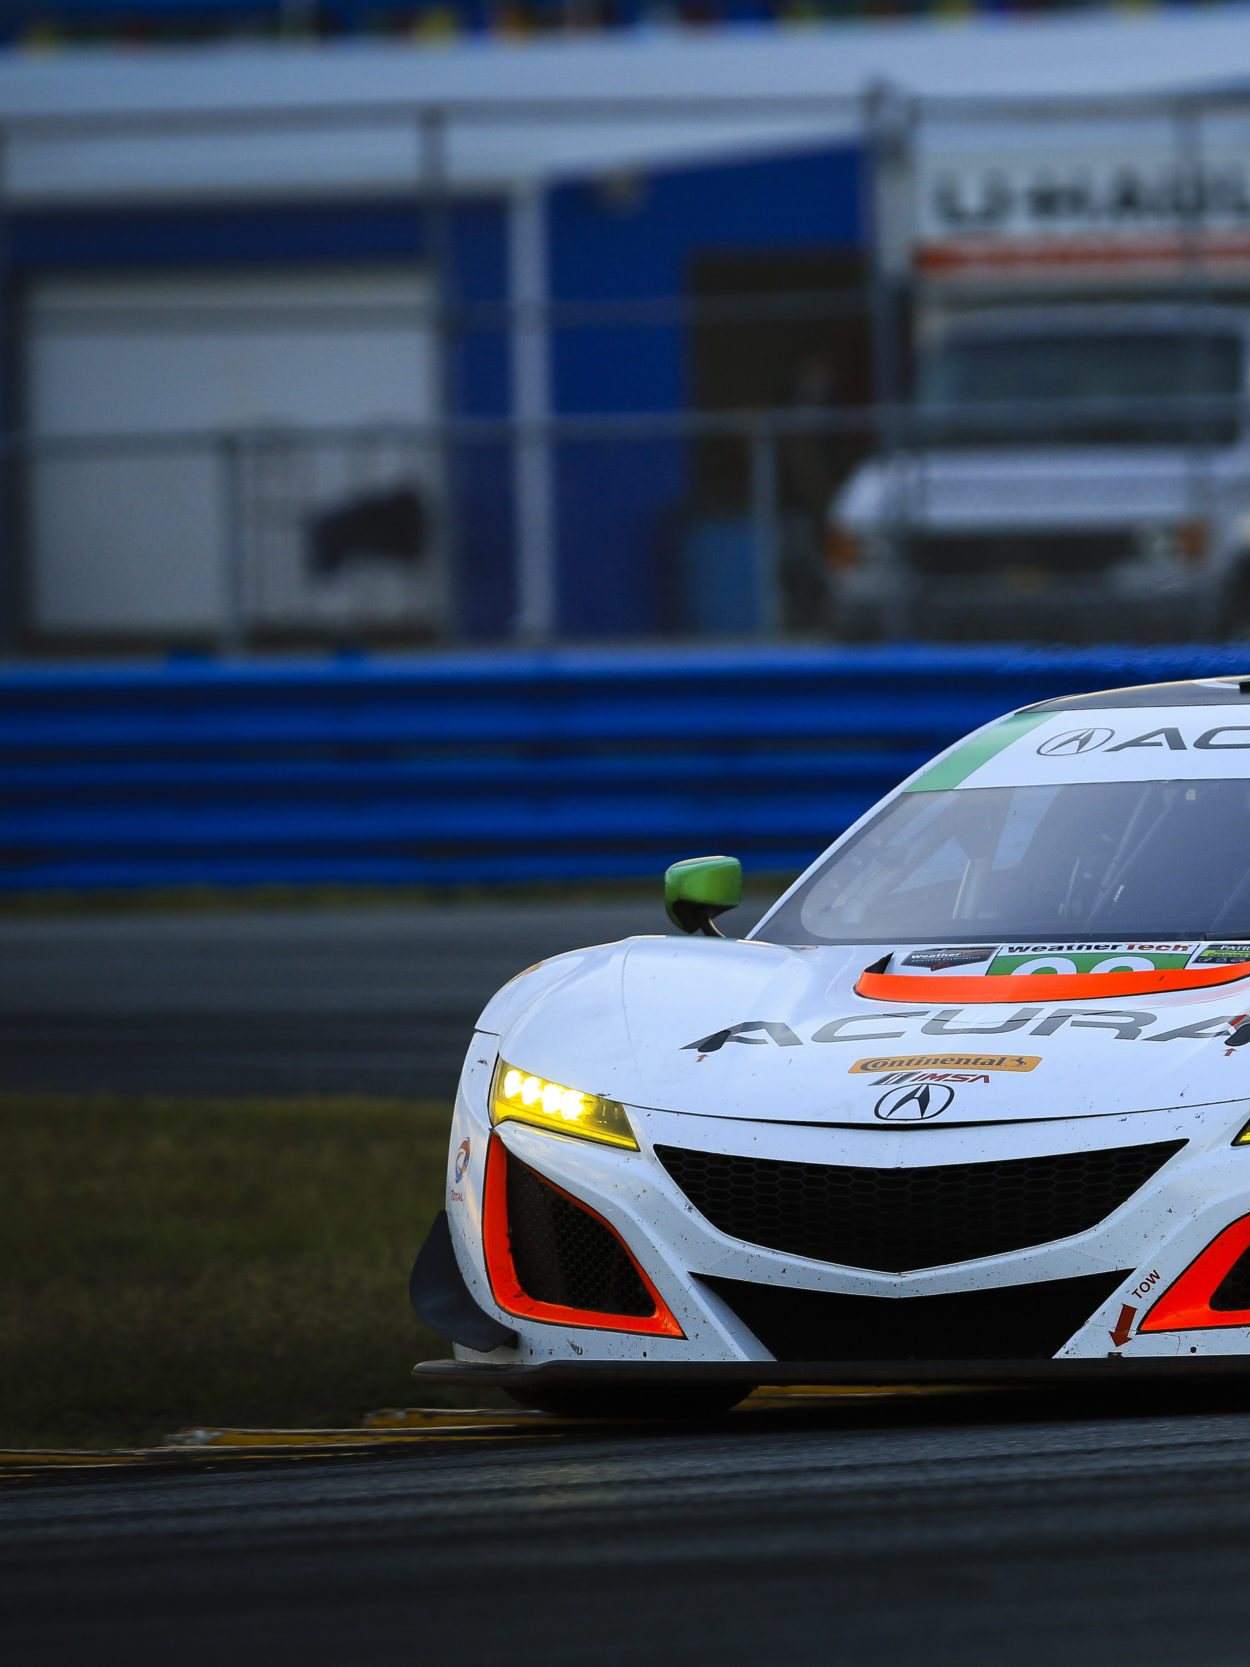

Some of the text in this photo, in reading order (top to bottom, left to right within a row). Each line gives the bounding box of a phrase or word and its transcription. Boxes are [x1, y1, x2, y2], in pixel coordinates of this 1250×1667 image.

[1007, 943, 1190, 954] WeatherTech
[860, 1056, 1008, 1072] Continental
[910, 1073, 990, 1084] IMSA
[1131, 1269, 1161, 1299] TOW
